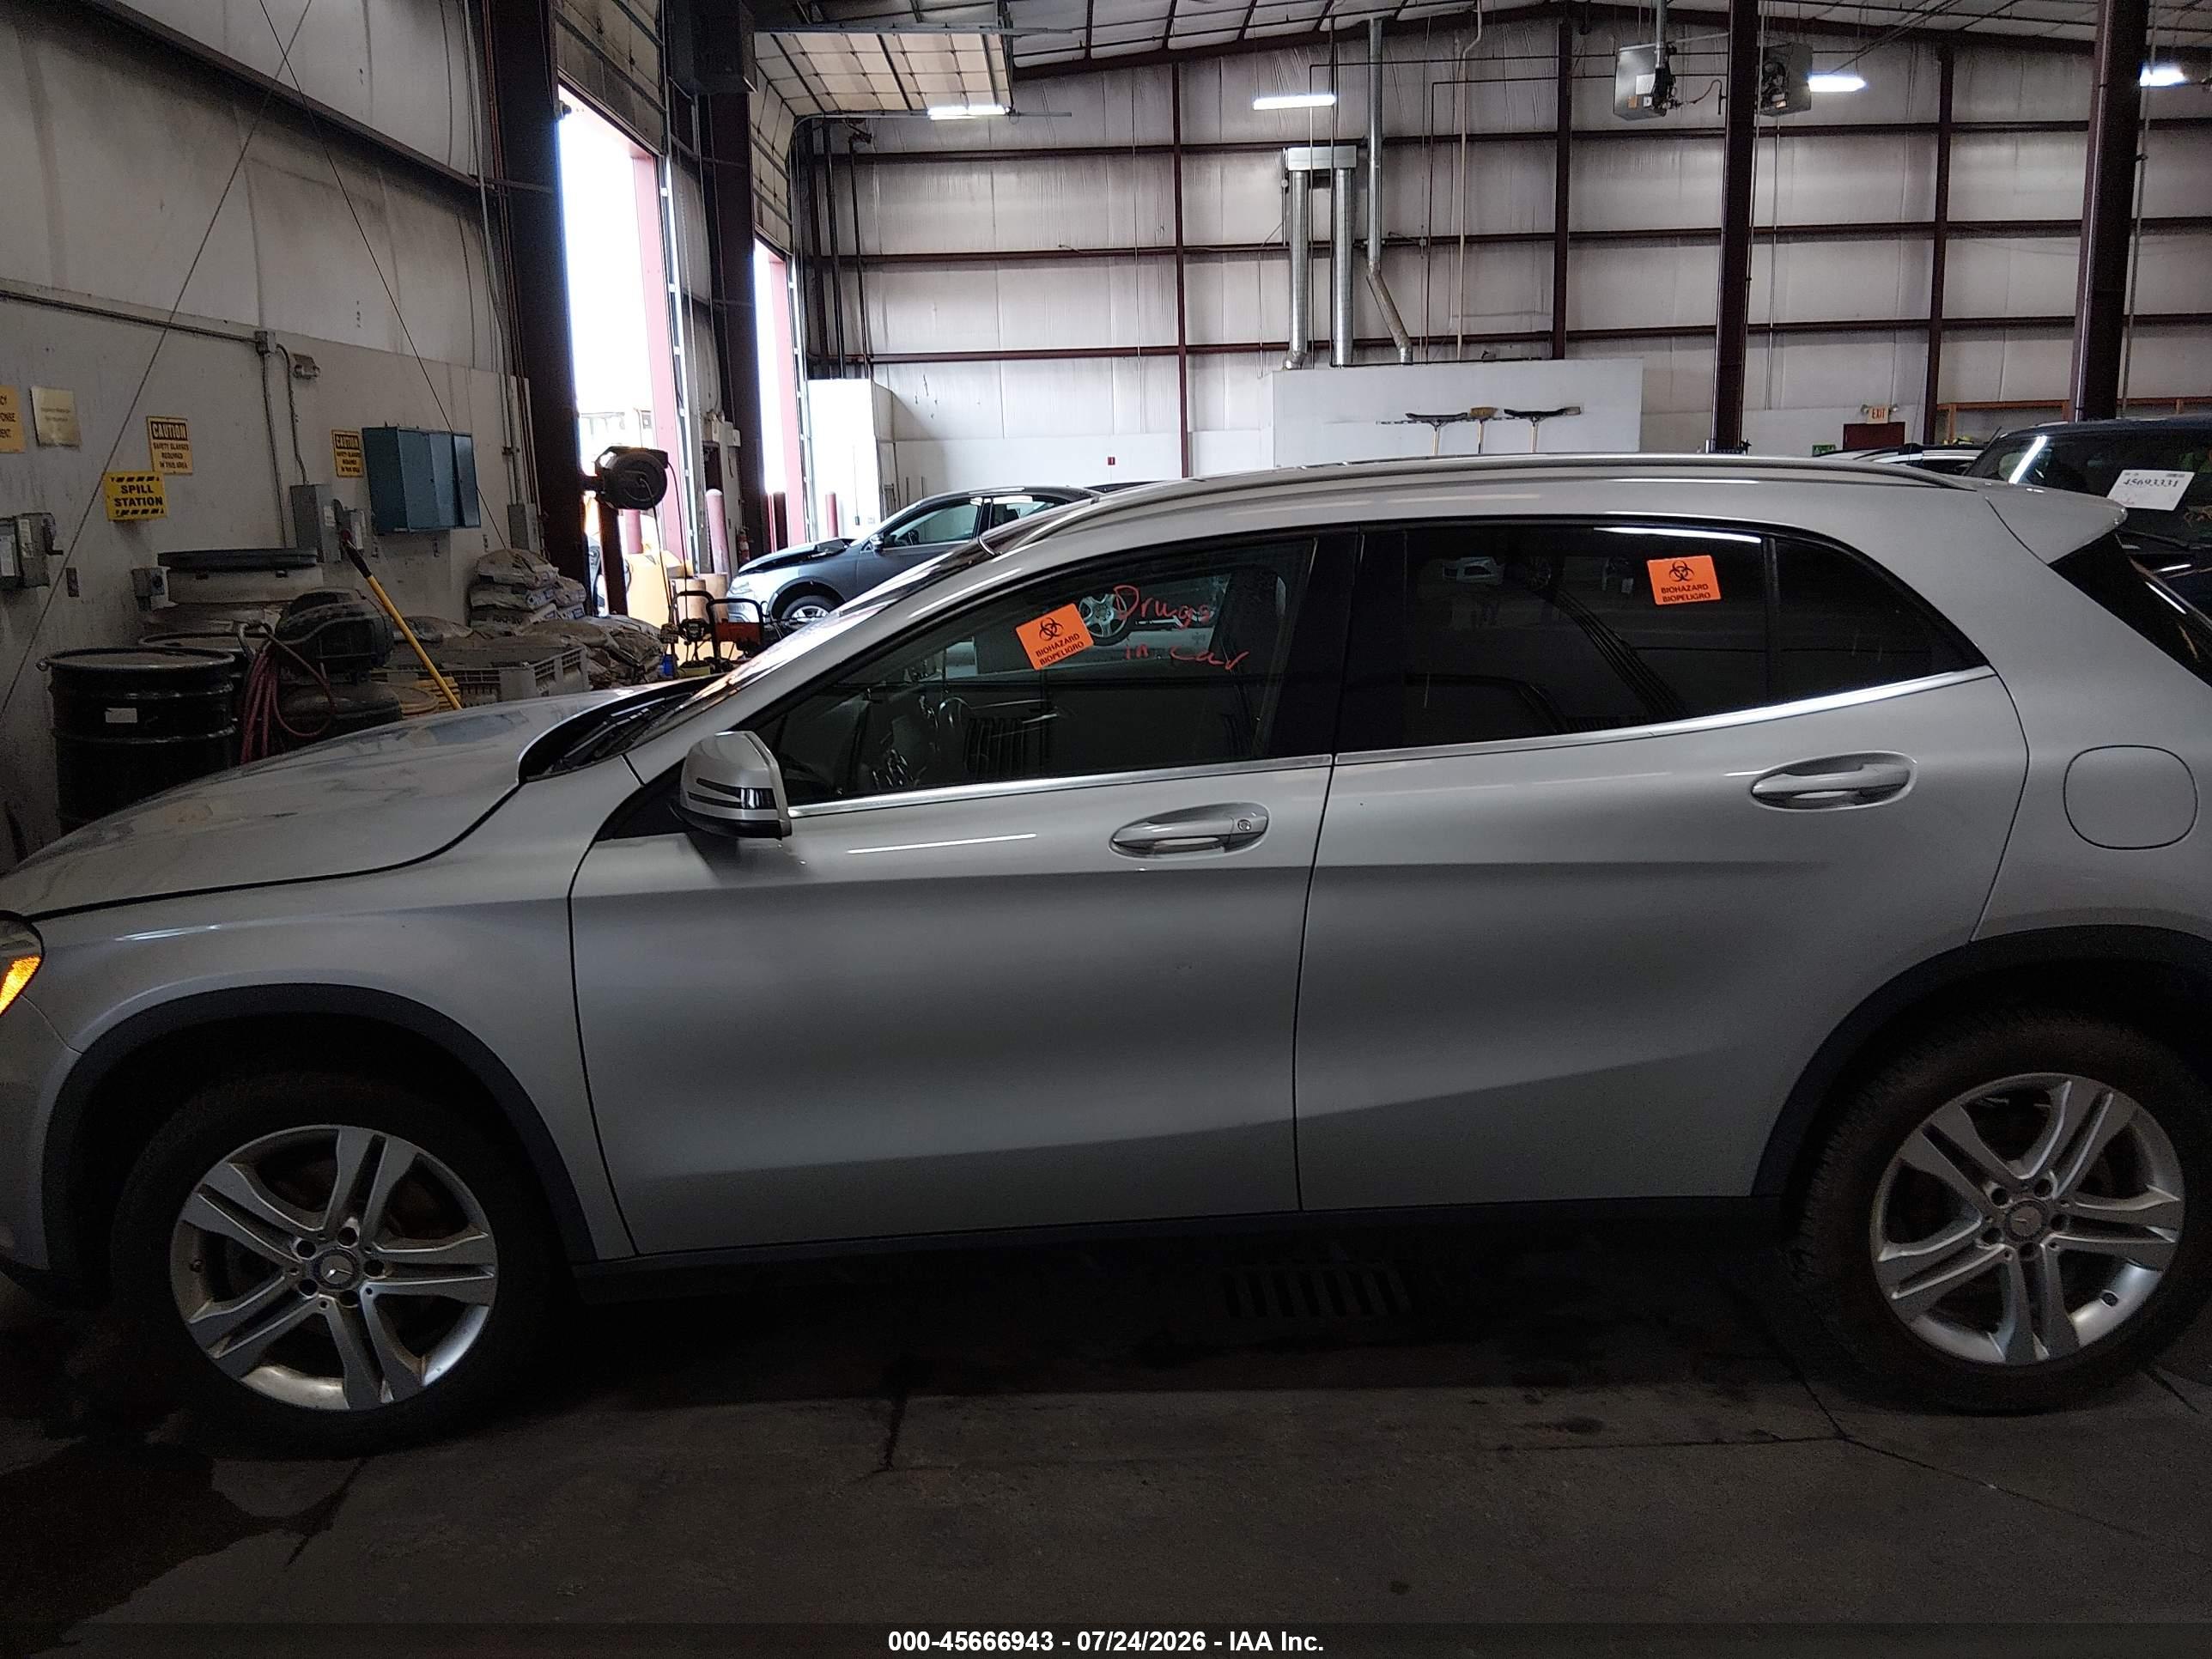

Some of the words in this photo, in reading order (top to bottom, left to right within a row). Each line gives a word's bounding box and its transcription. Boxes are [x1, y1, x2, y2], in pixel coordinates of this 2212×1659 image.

[1872, 408, 1886, 419] EXIT
[151, 423, 186, 440] CAUTION
[336, 434, 359, 448] CAUTION
[121, 484, 154, 494] SPILL
[114, 496, 163, 507] STATION
[1661, 584, 1709, 593] BIOHAZARD
[1662, 592, 1711, 602] BIOPELIGRO
[1036, 633, 1080, 657] BIOHAZARD
[1125, 643, 1149, 659] in
[1039, 641, 1085, 665] BIOPELIGRO
